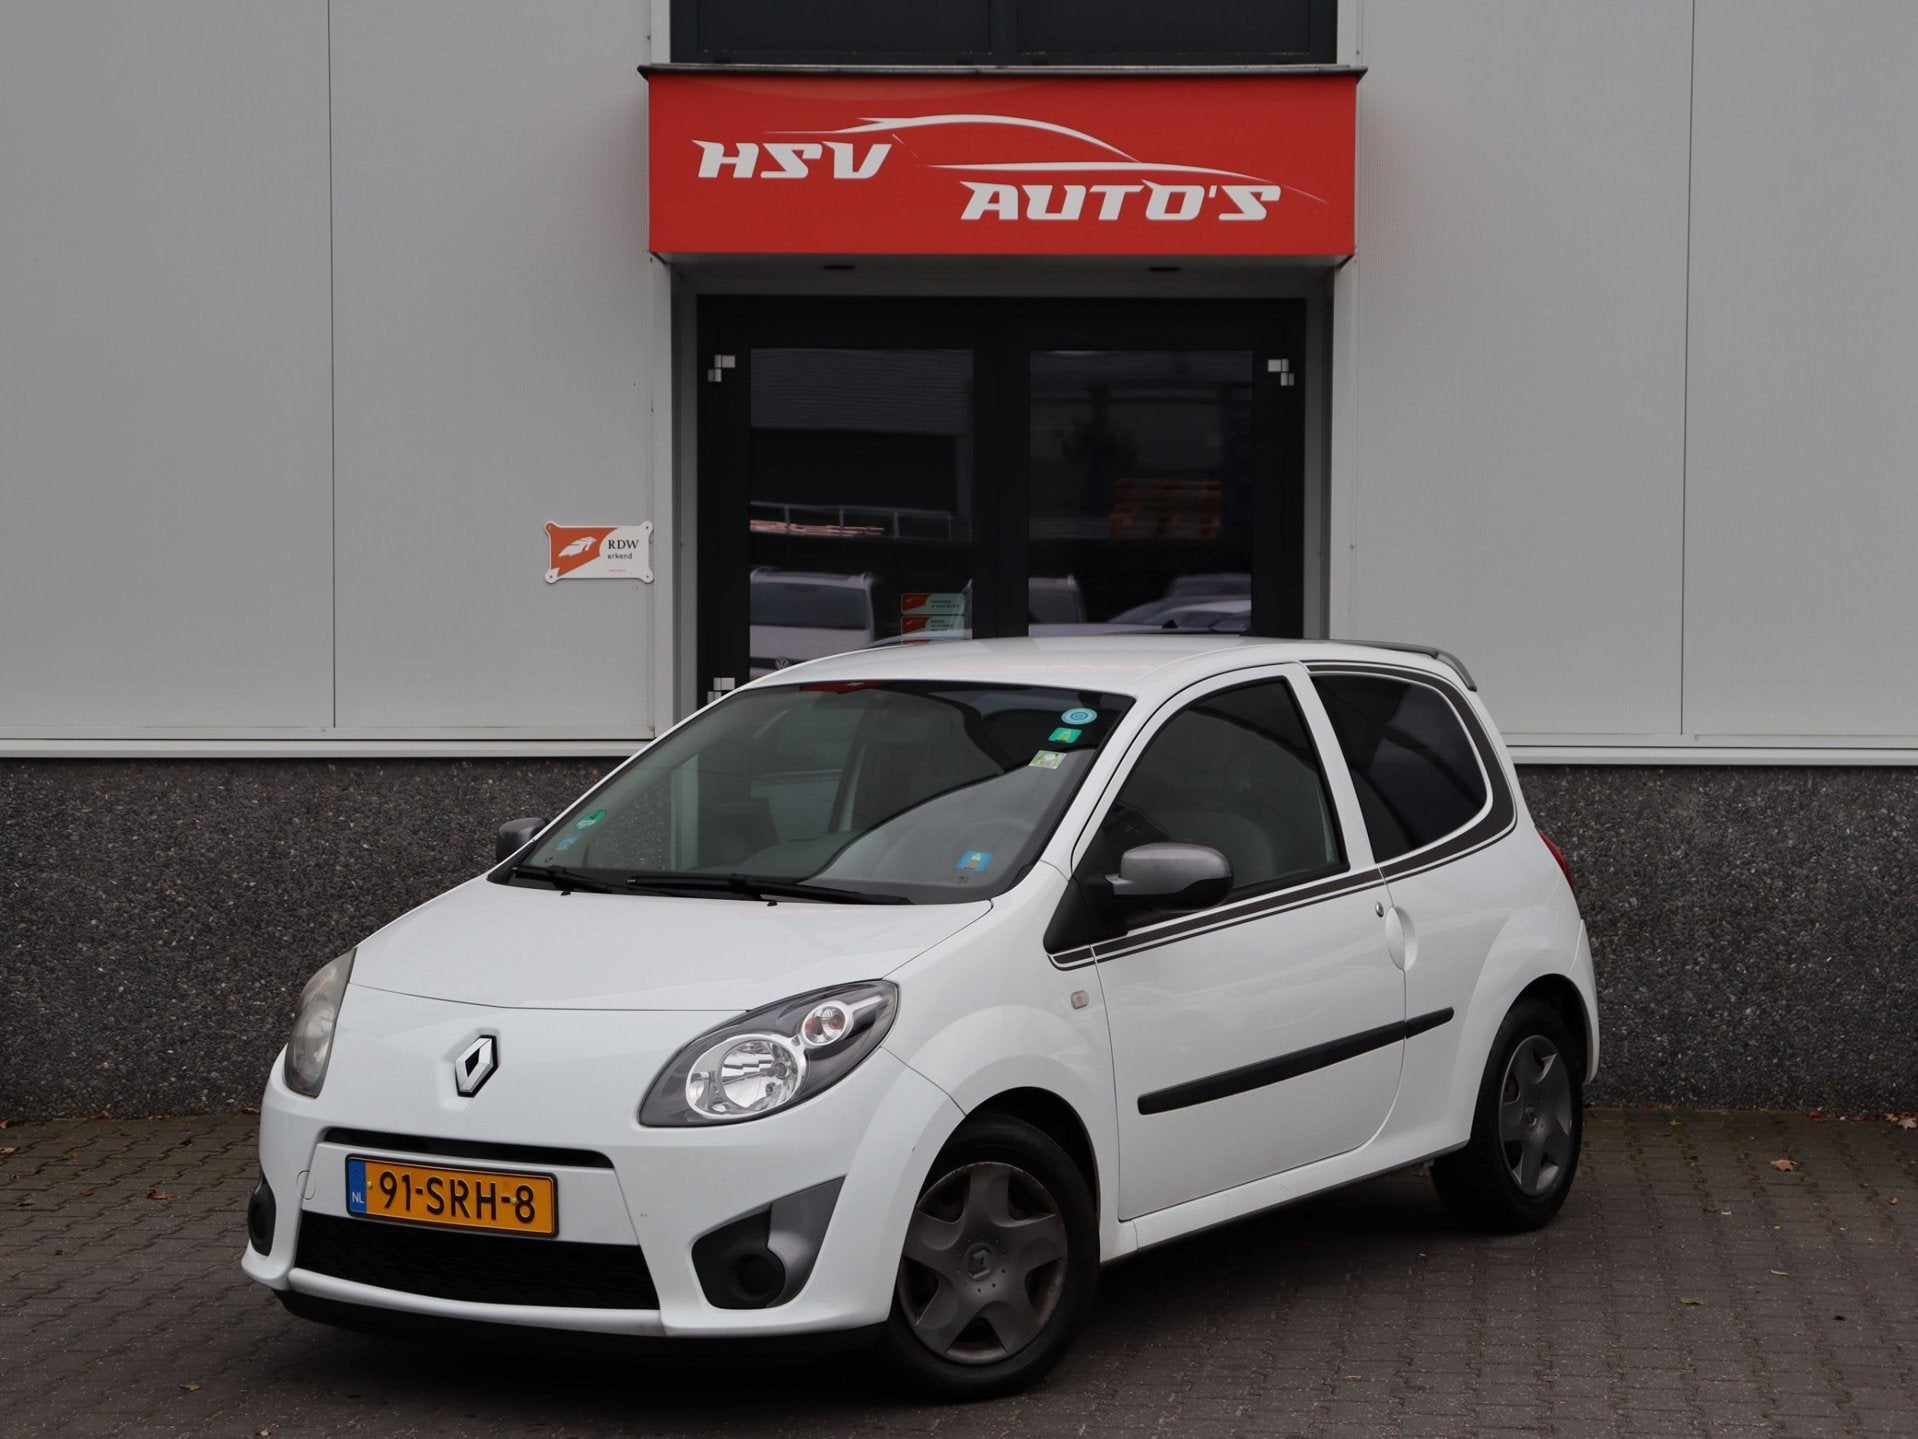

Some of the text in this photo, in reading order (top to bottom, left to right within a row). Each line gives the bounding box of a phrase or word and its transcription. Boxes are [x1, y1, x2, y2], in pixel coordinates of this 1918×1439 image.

[692, 140, 892, 180] HSV
[960, 179, 1282, 221] AUTO'S
[607, 552, 633, 560] erkend
[608, 539, 640, 550] RDW
[351, 1191, 365, 1204] NL
[379, 1171, 536, 1224] 91-SRH-8
